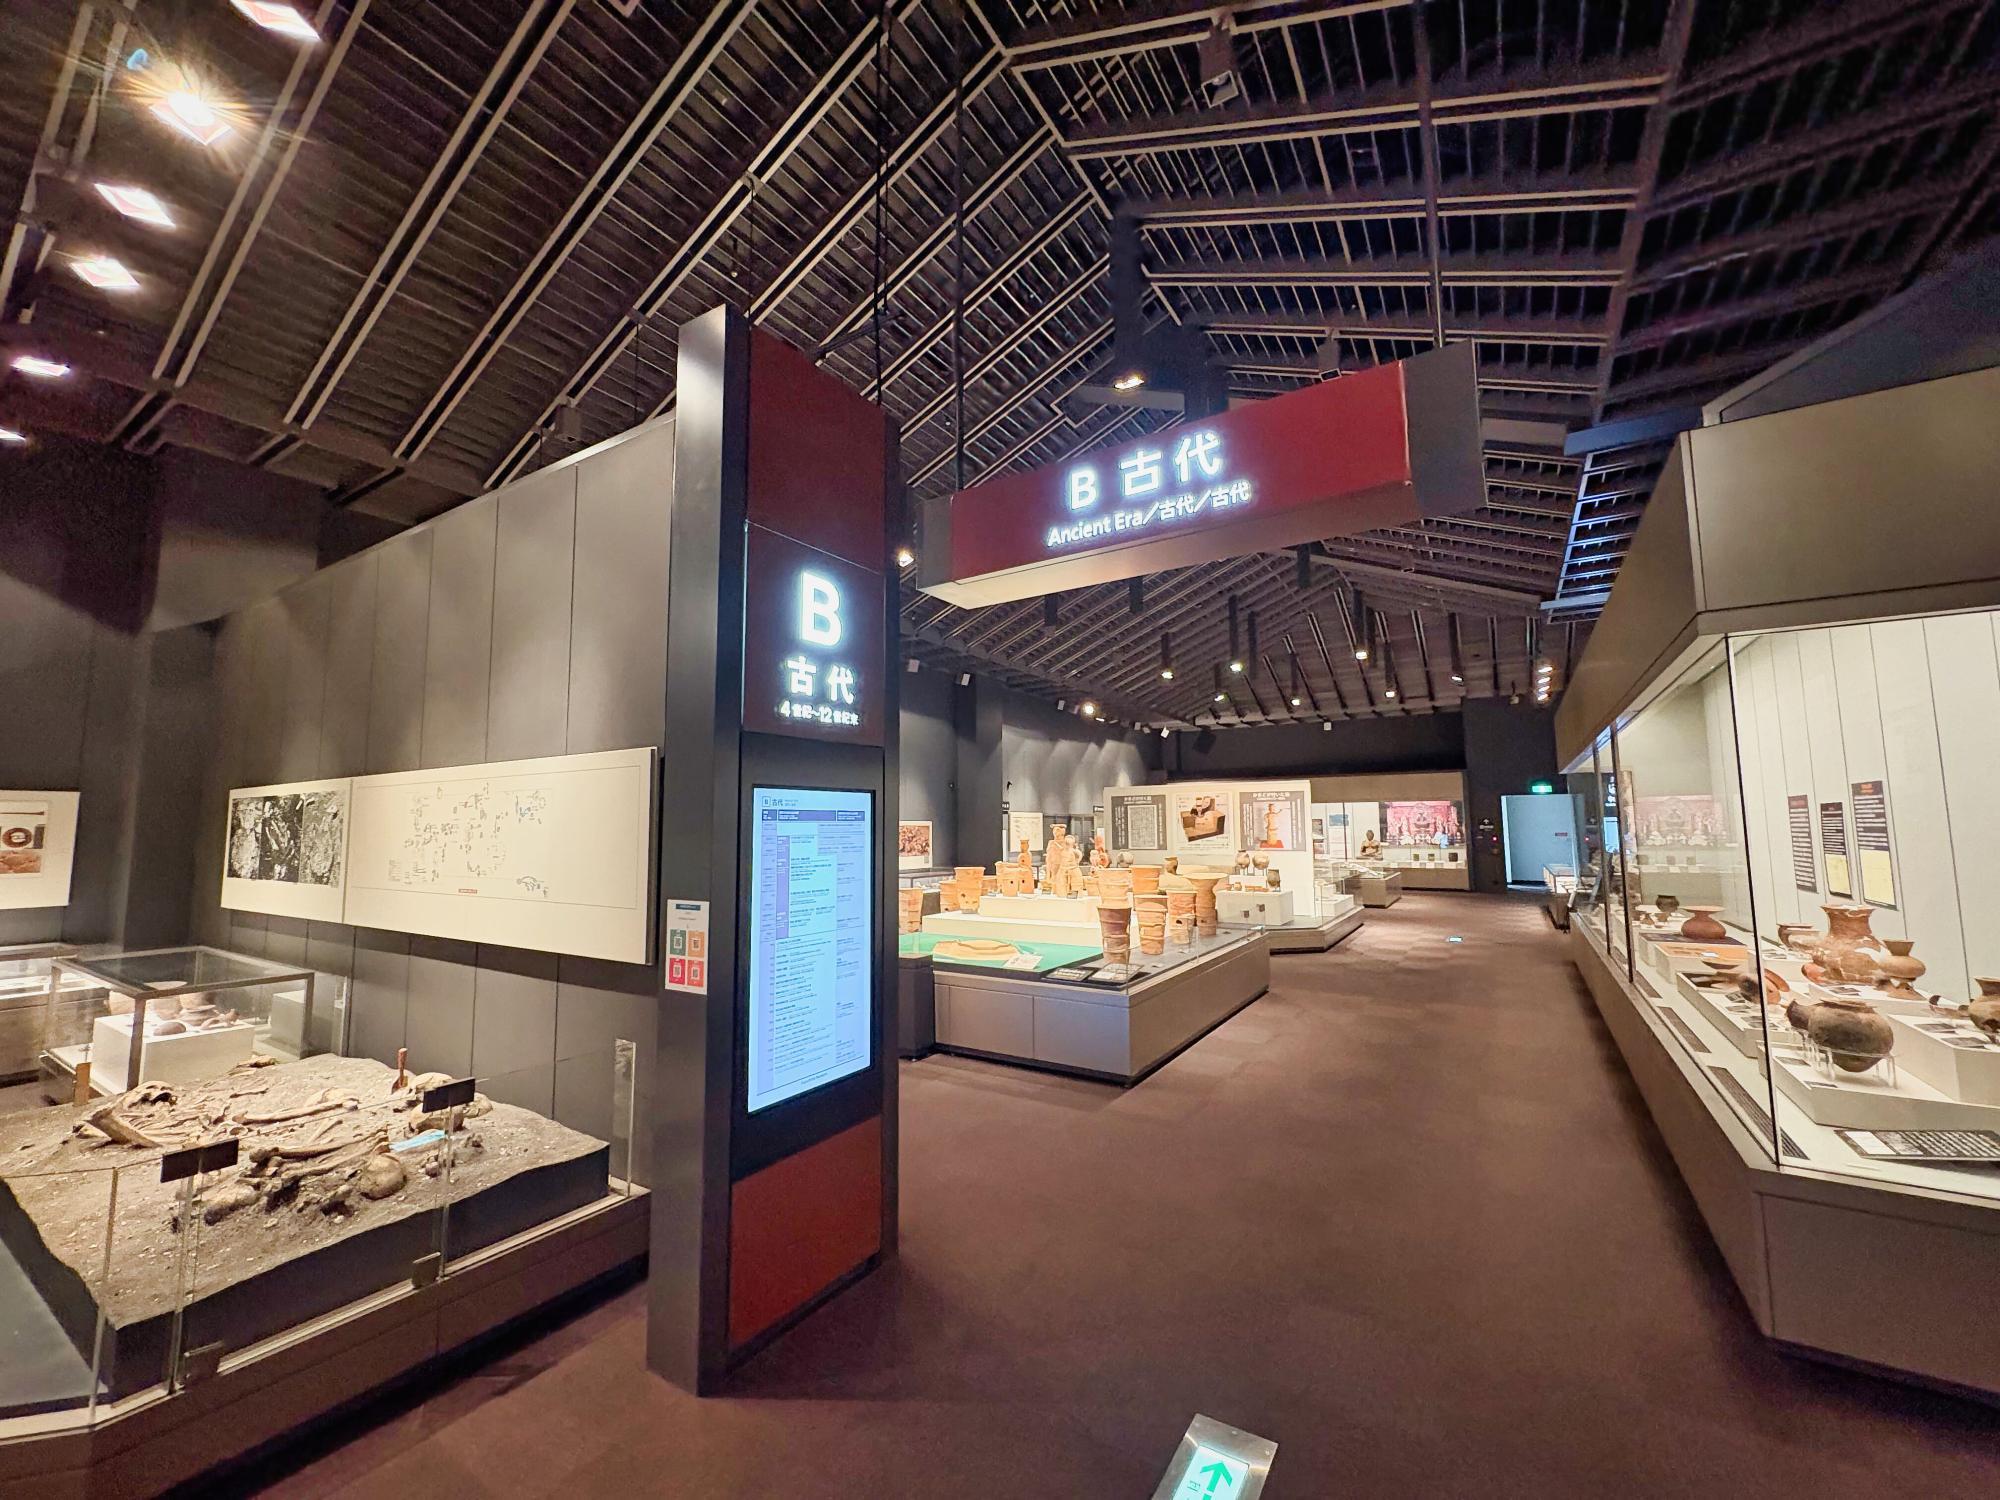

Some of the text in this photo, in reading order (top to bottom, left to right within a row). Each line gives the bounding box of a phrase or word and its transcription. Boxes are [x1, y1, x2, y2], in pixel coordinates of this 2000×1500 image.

[1070, 432, 1223, 510] B 古代
[1047, 517, 1112, 547] Ancient
[801, 572, 842, 646] B
[786, 655, 855, 705] 古代
